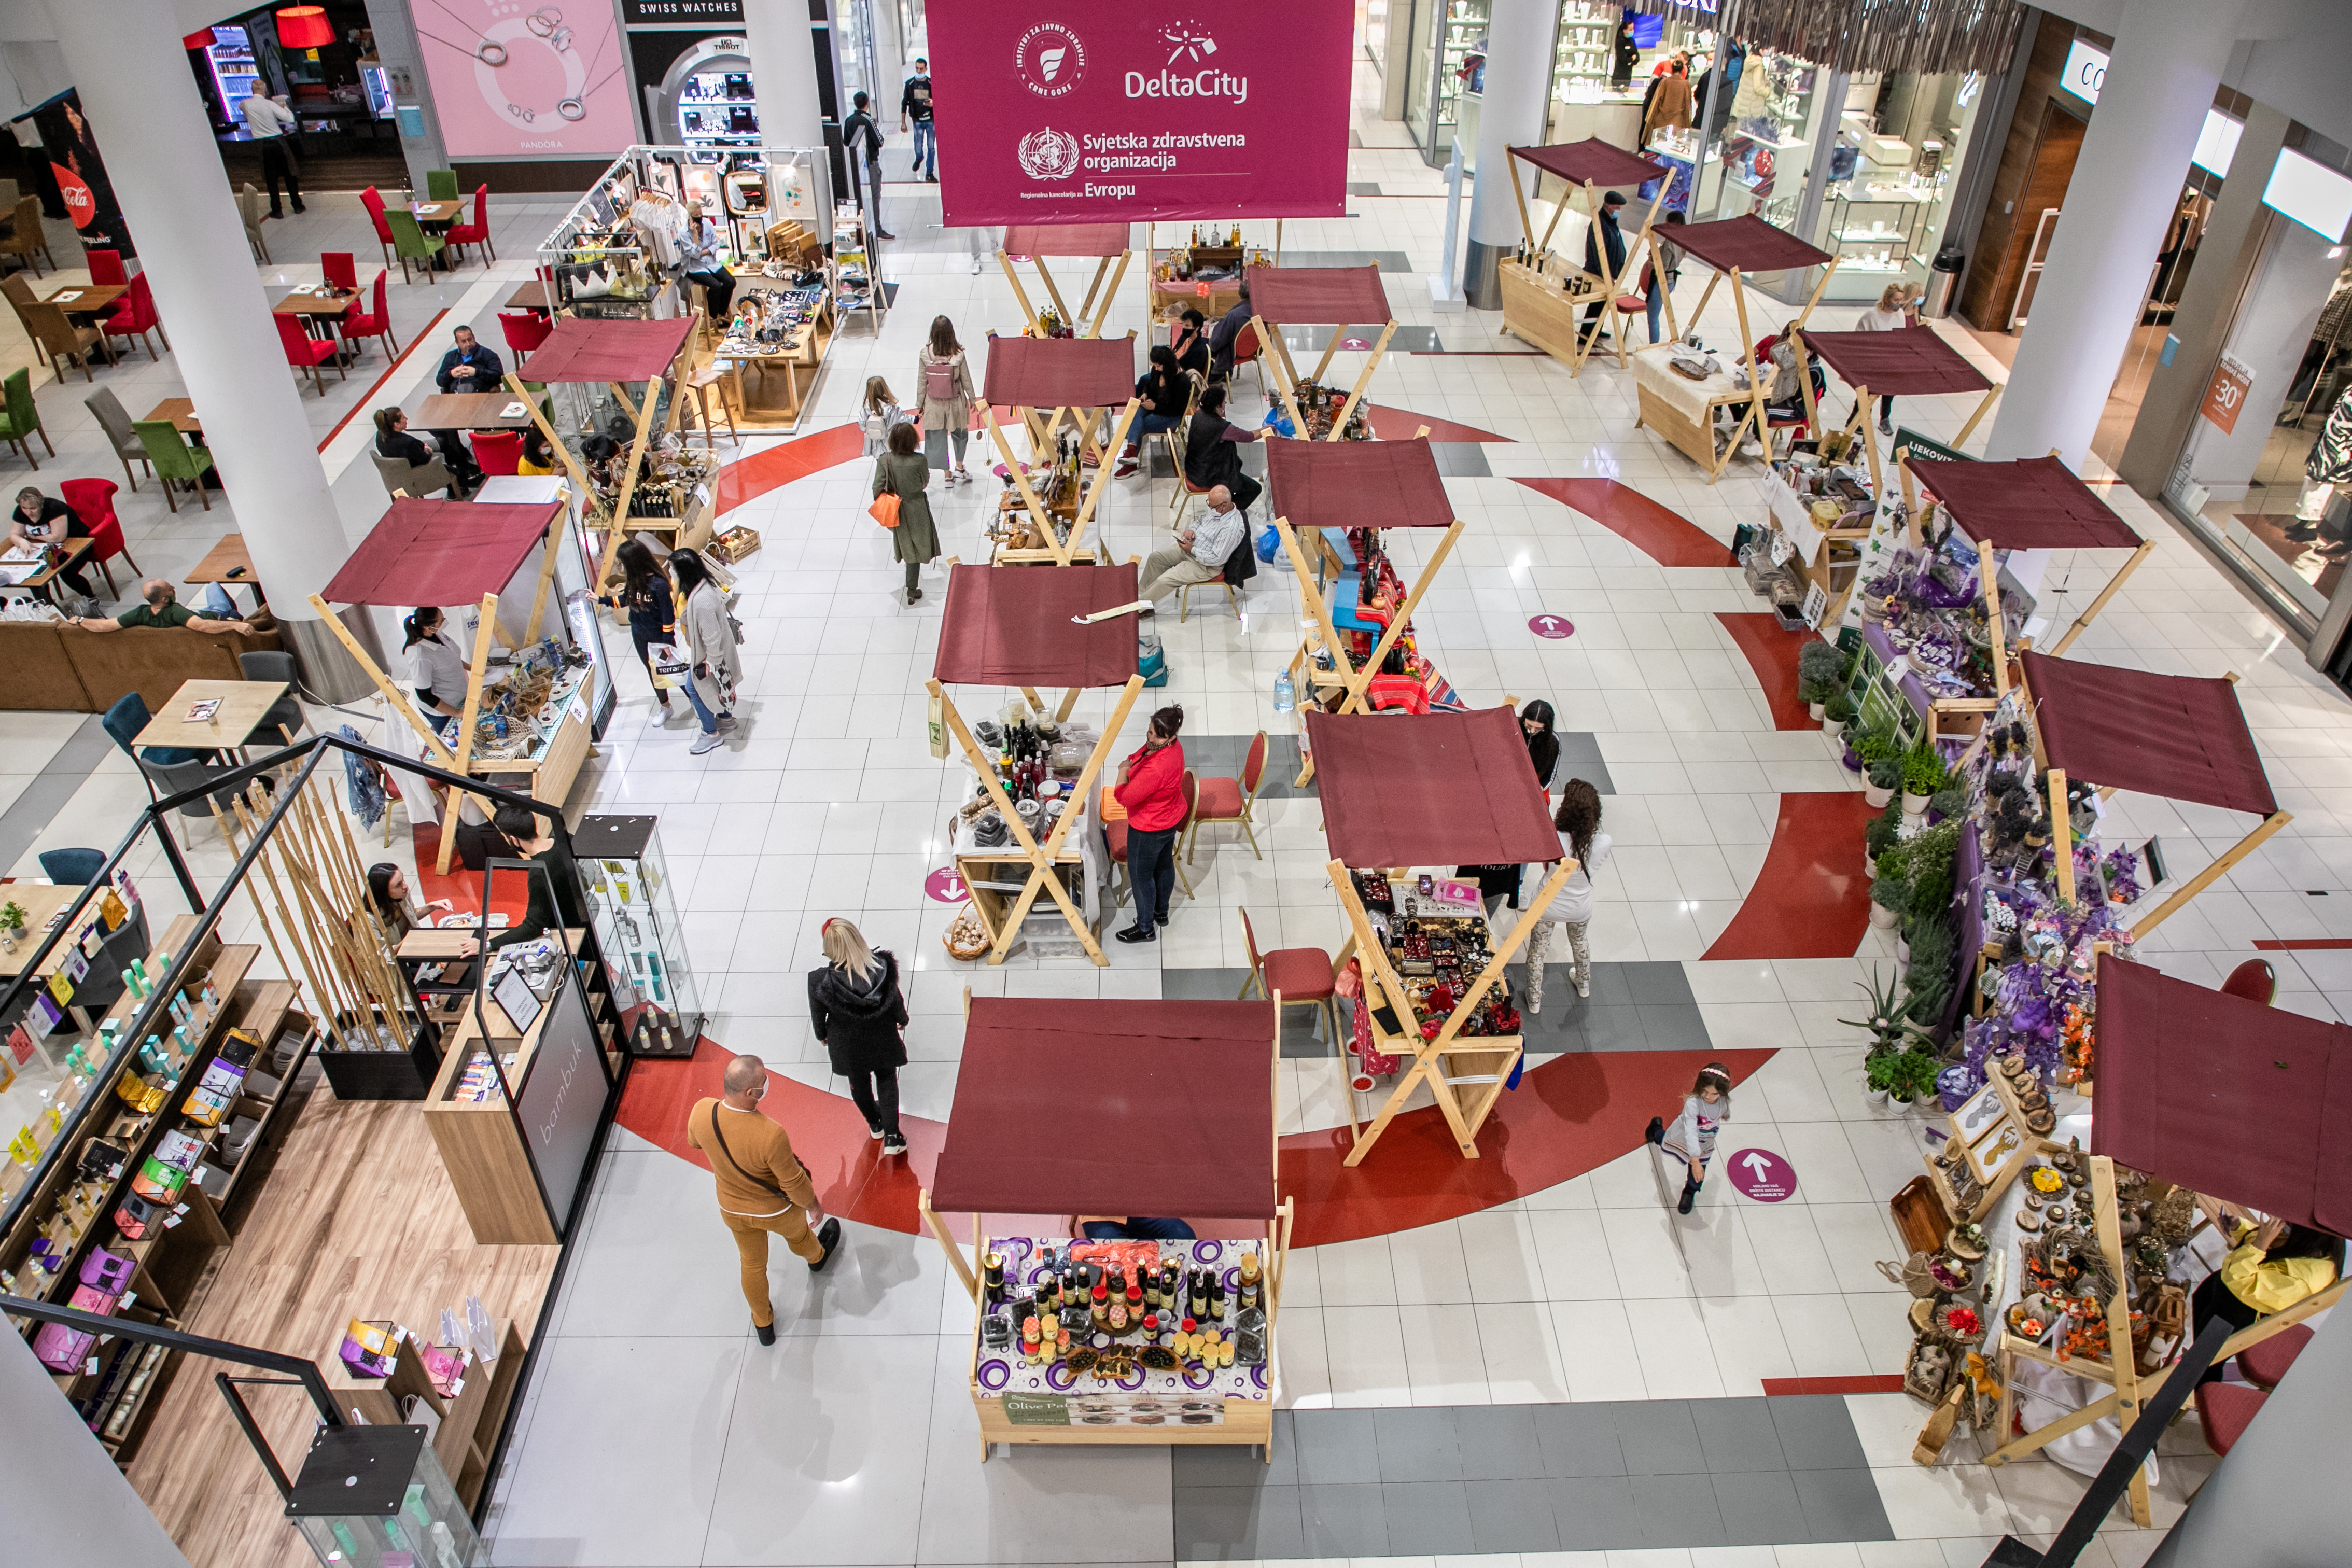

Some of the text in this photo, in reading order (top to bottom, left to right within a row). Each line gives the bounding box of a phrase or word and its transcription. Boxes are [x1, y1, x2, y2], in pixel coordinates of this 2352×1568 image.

[640, 2, 737, 13] SWISS WATCHES
[1016, 23, 1085, 68] INSTITUT ZA JAVNO ZDRAVLJE
[1028, 82, 1072, 96] CRNE GORE
[1125, 69, 1247, 104] DeltaCity
[1083, 131, 1245, 154] Svjetska zdravstvena
[1084, 151, 1177, 173] organizacija
[1085, 183, 1136, 200] Evropu
[2228, 357, 2249, 376] NEDJELJA
[2236, 372, 2251, 386] MODE
[1909, 441, 1957, 462] LJEKOVIT
[540, 1038, 582, 1146] bambuk
